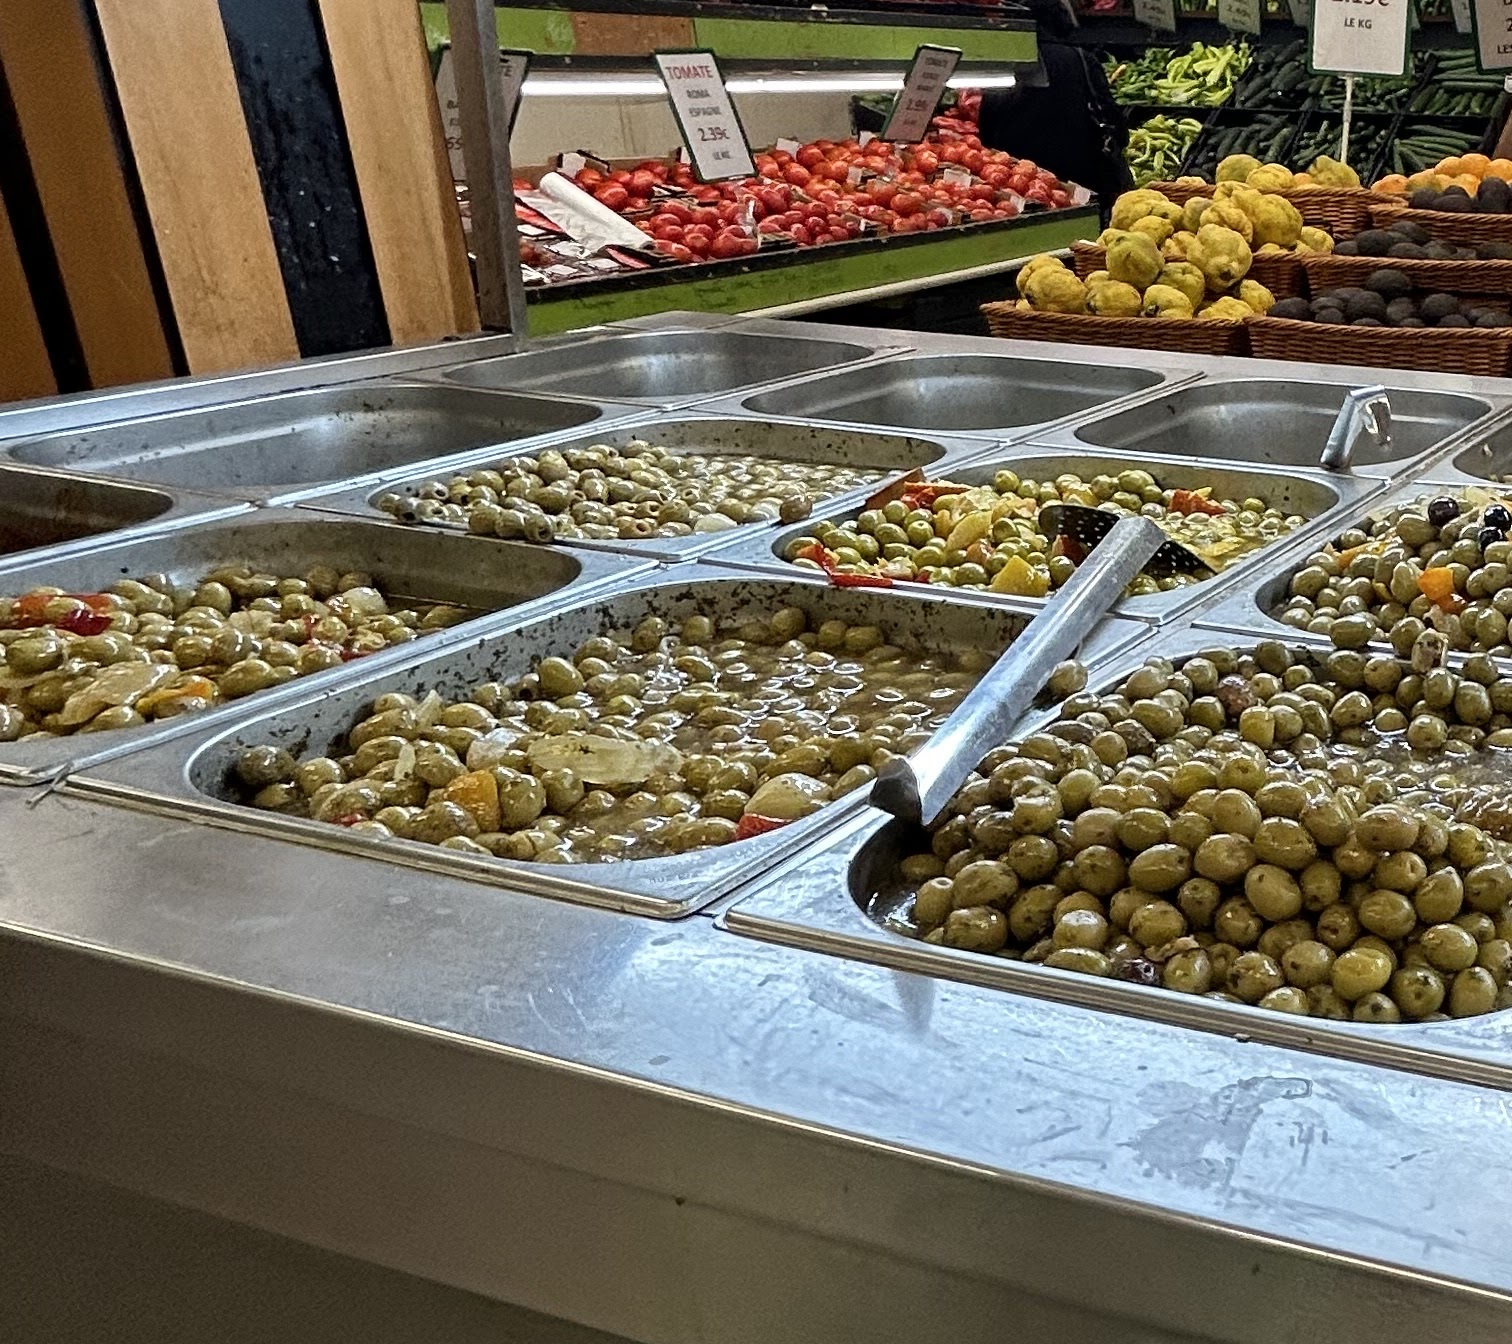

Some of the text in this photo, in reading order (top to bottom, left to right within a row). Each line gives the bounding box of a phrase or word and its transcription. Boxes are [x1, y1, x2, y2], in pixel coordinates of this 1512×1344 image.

[1344, 17, 1372, 29] LE KG
[665, 65, 714, 79] TOMATE
